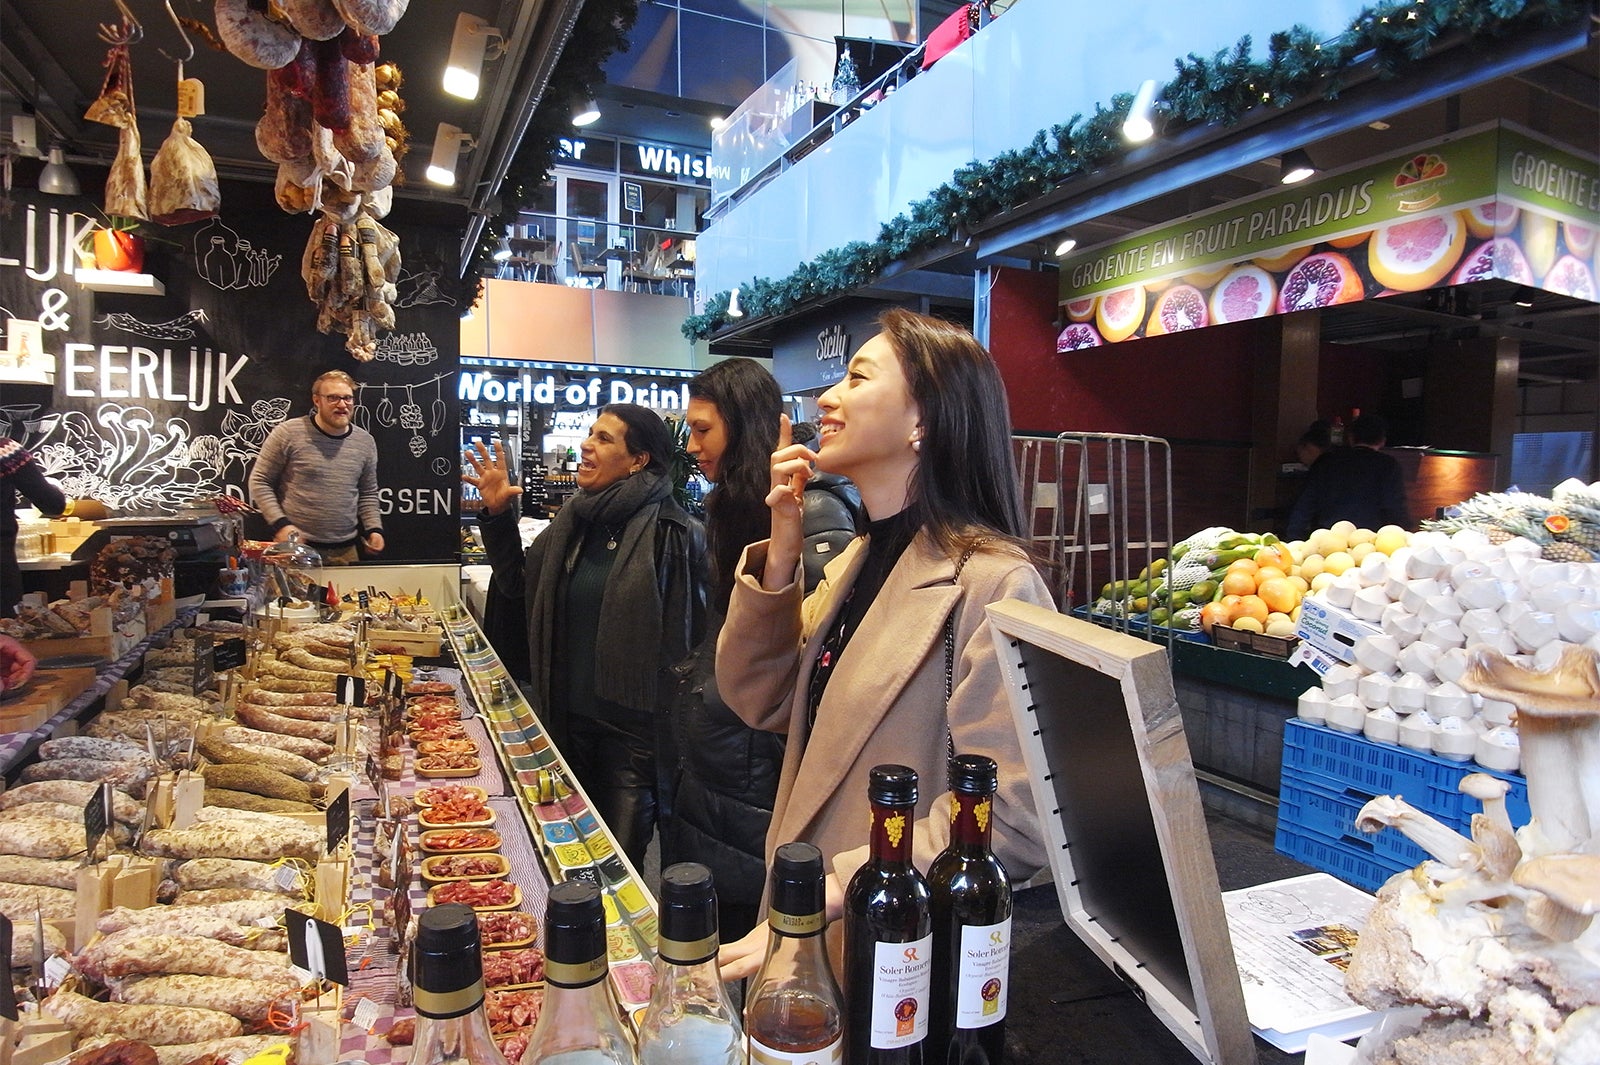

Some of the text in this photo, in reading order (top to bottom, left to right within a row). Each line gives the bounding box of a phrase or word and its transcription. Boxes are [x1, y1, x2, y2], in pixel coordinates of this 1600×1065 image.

[1511, 152, 1587, 206] GROENTE
[0, 204, 97, 281] IJK
[1072, 245, 1149, 289] GROENTE
[1150, 237, 1177, 269] EN
[1179, 217, 1245, 262] FRUIT
[1247, 179, 1375, 244] PARADIJS
[816, 324, 847, 366] Sicily
[65, 343, 249, 411] EERLIJK
[565, 377, 602, 405] of
[879, 964, 904, 976] Soler
